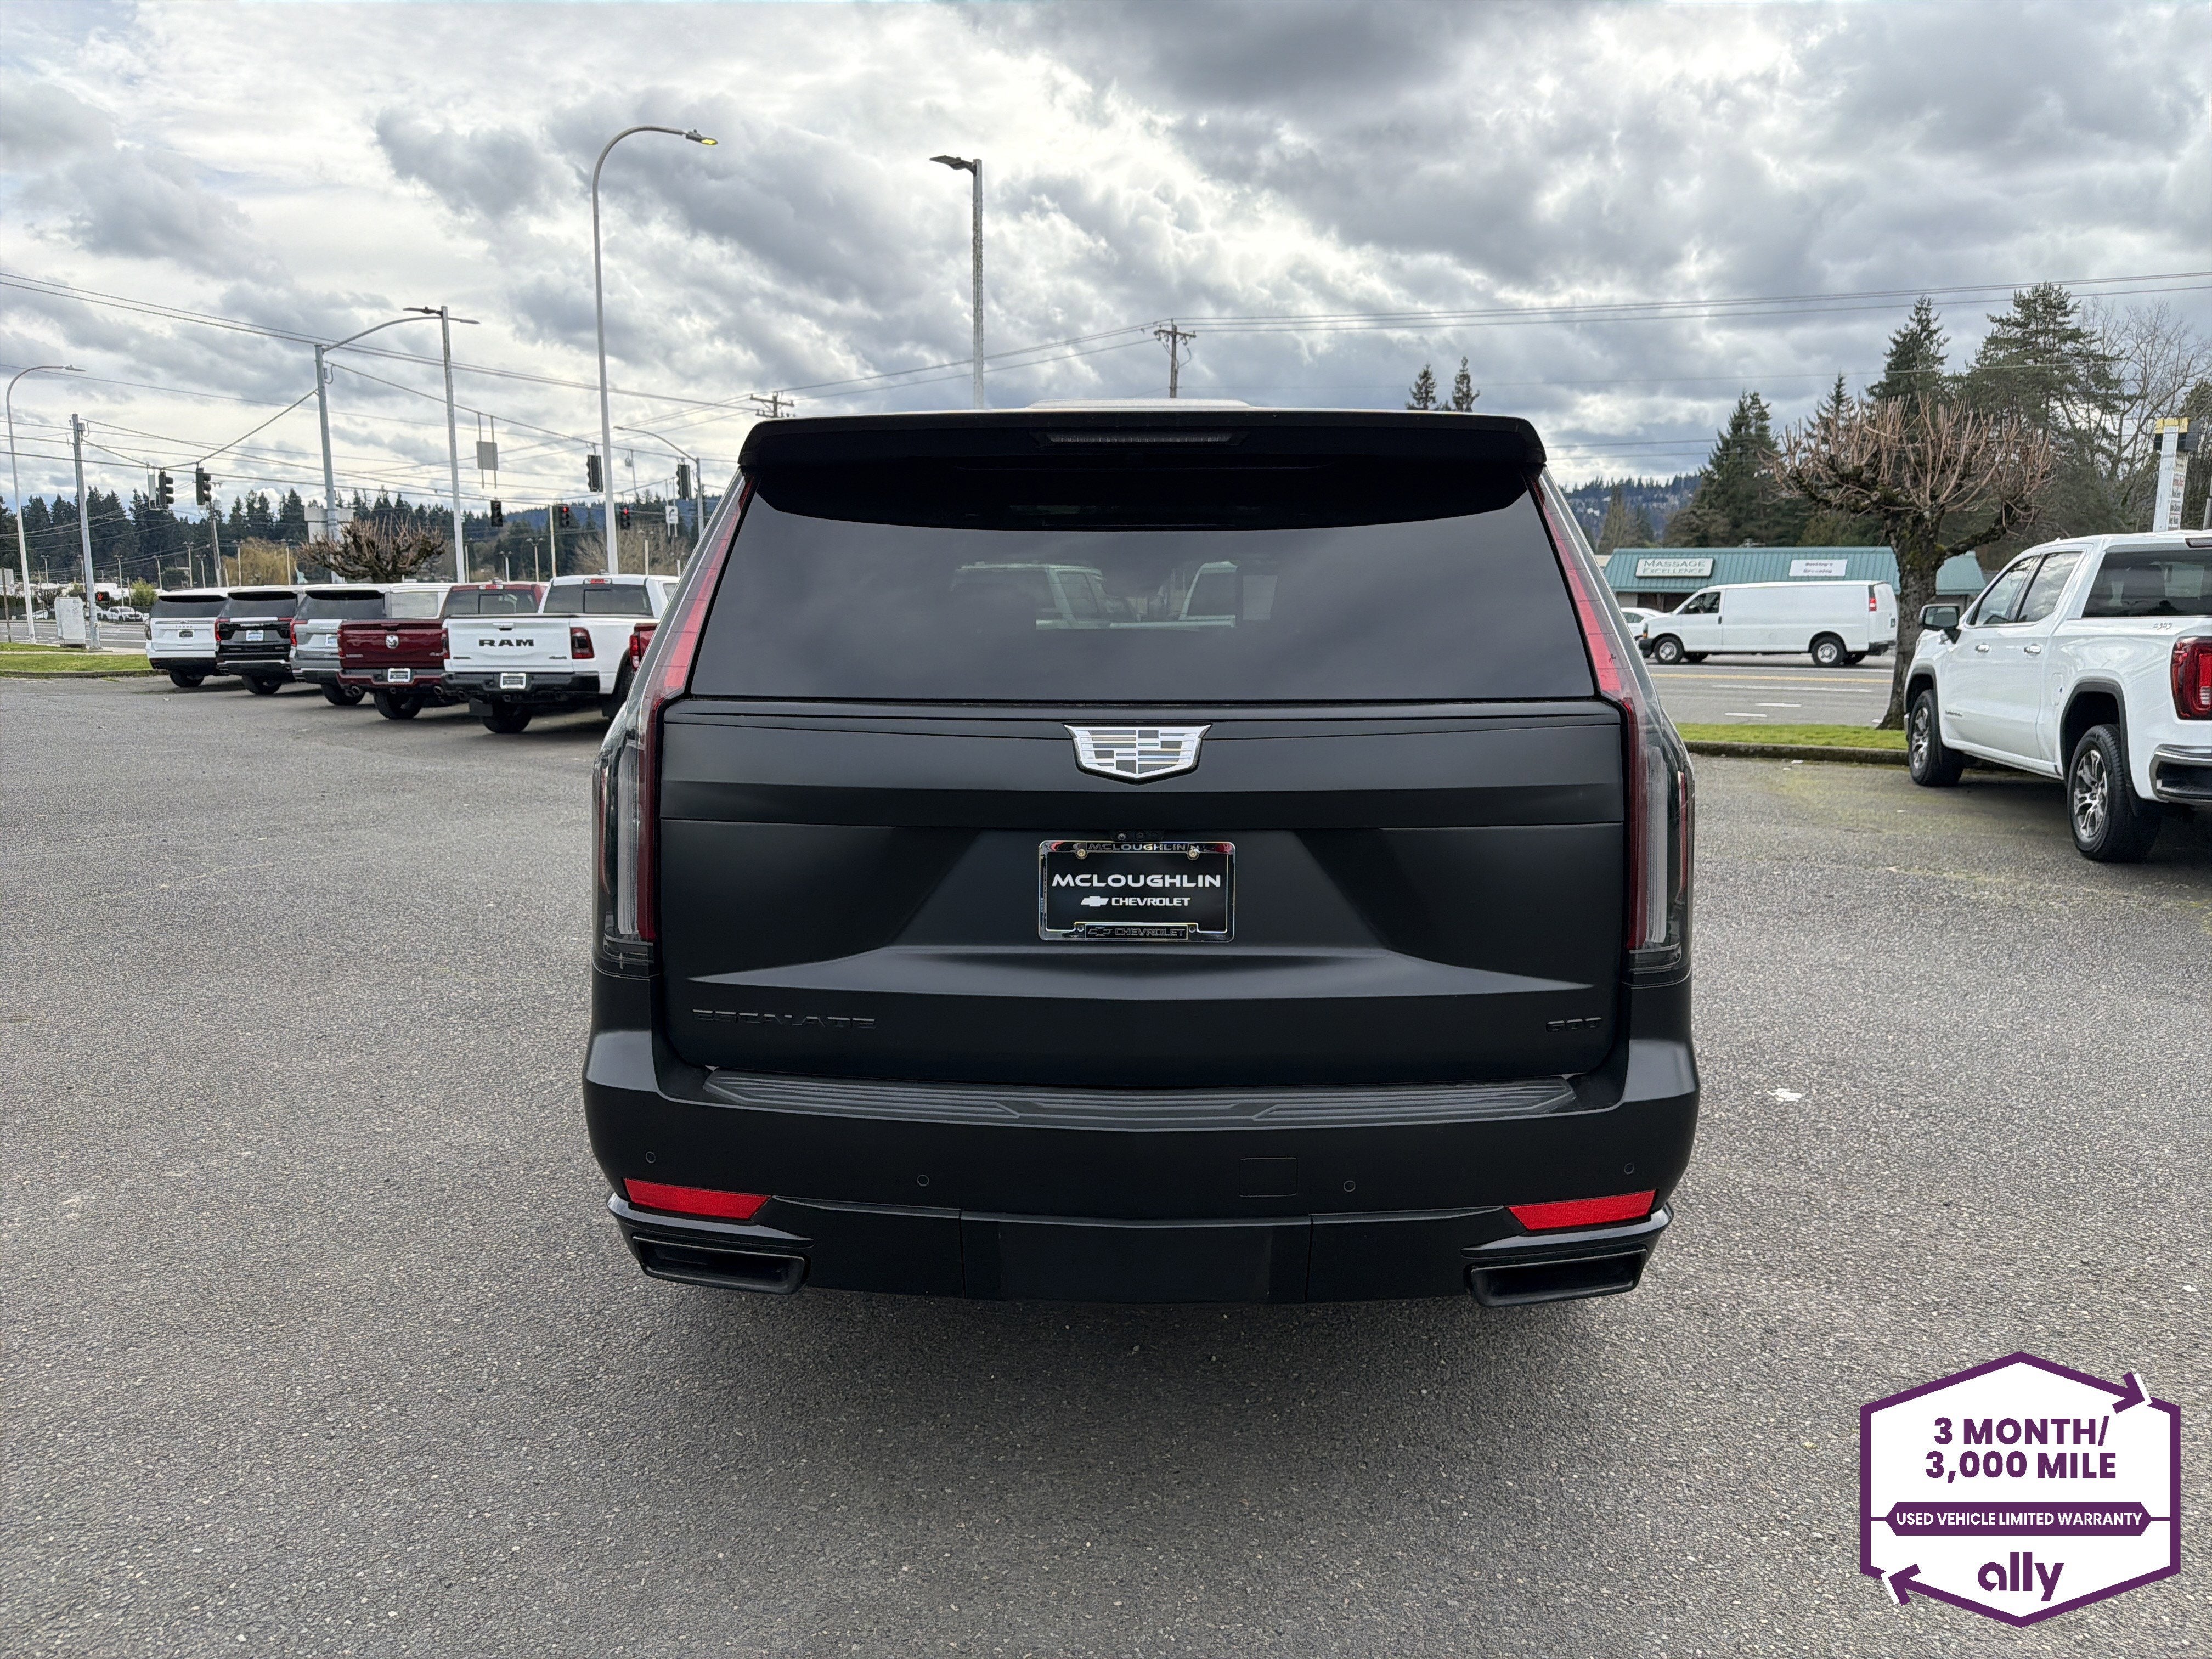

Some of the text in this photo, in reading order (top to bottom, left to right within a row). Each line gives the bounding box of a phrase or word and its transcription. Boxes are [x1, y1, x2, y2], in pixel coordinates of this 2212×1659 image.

[478, 639, 534, 647] RAM
[1088, 843, 1186, 851] MCLOUGHLIN
[1052, 874, 1221, 888] MCLOUGHLIN
[1111, 897, 1191, 906] CHEVROLET
[1114, 928, 1186, 936] CHEVROLET
